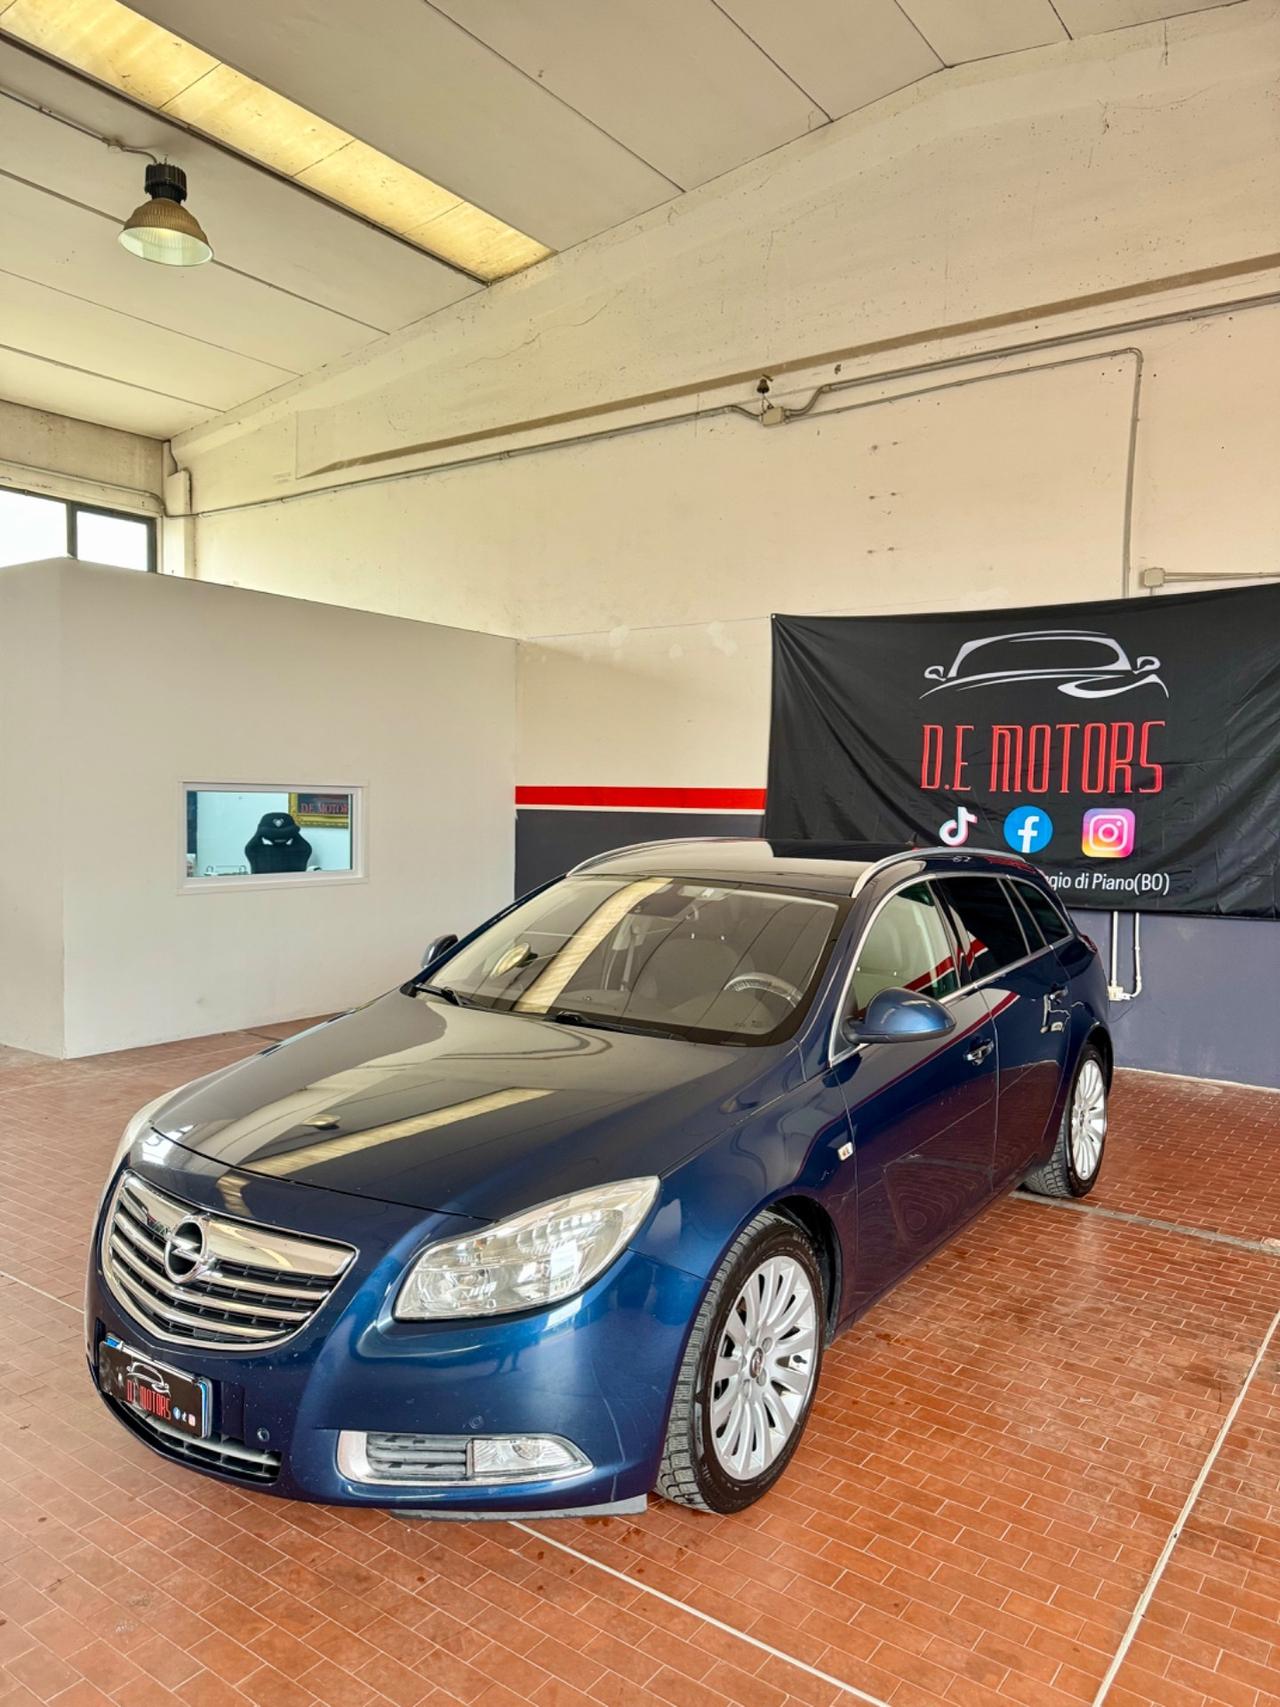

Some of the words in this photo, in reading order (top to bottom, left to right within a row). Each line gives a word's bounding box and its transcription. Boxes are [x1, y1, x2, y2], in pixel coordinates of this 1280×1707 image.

[920, 724, 975, 791] D.E
[989, 720, 1166, 794] MOTORS
[1074, 872, 1089, 889] di
[1092, 872, 1171, 896] Piano(BO)
